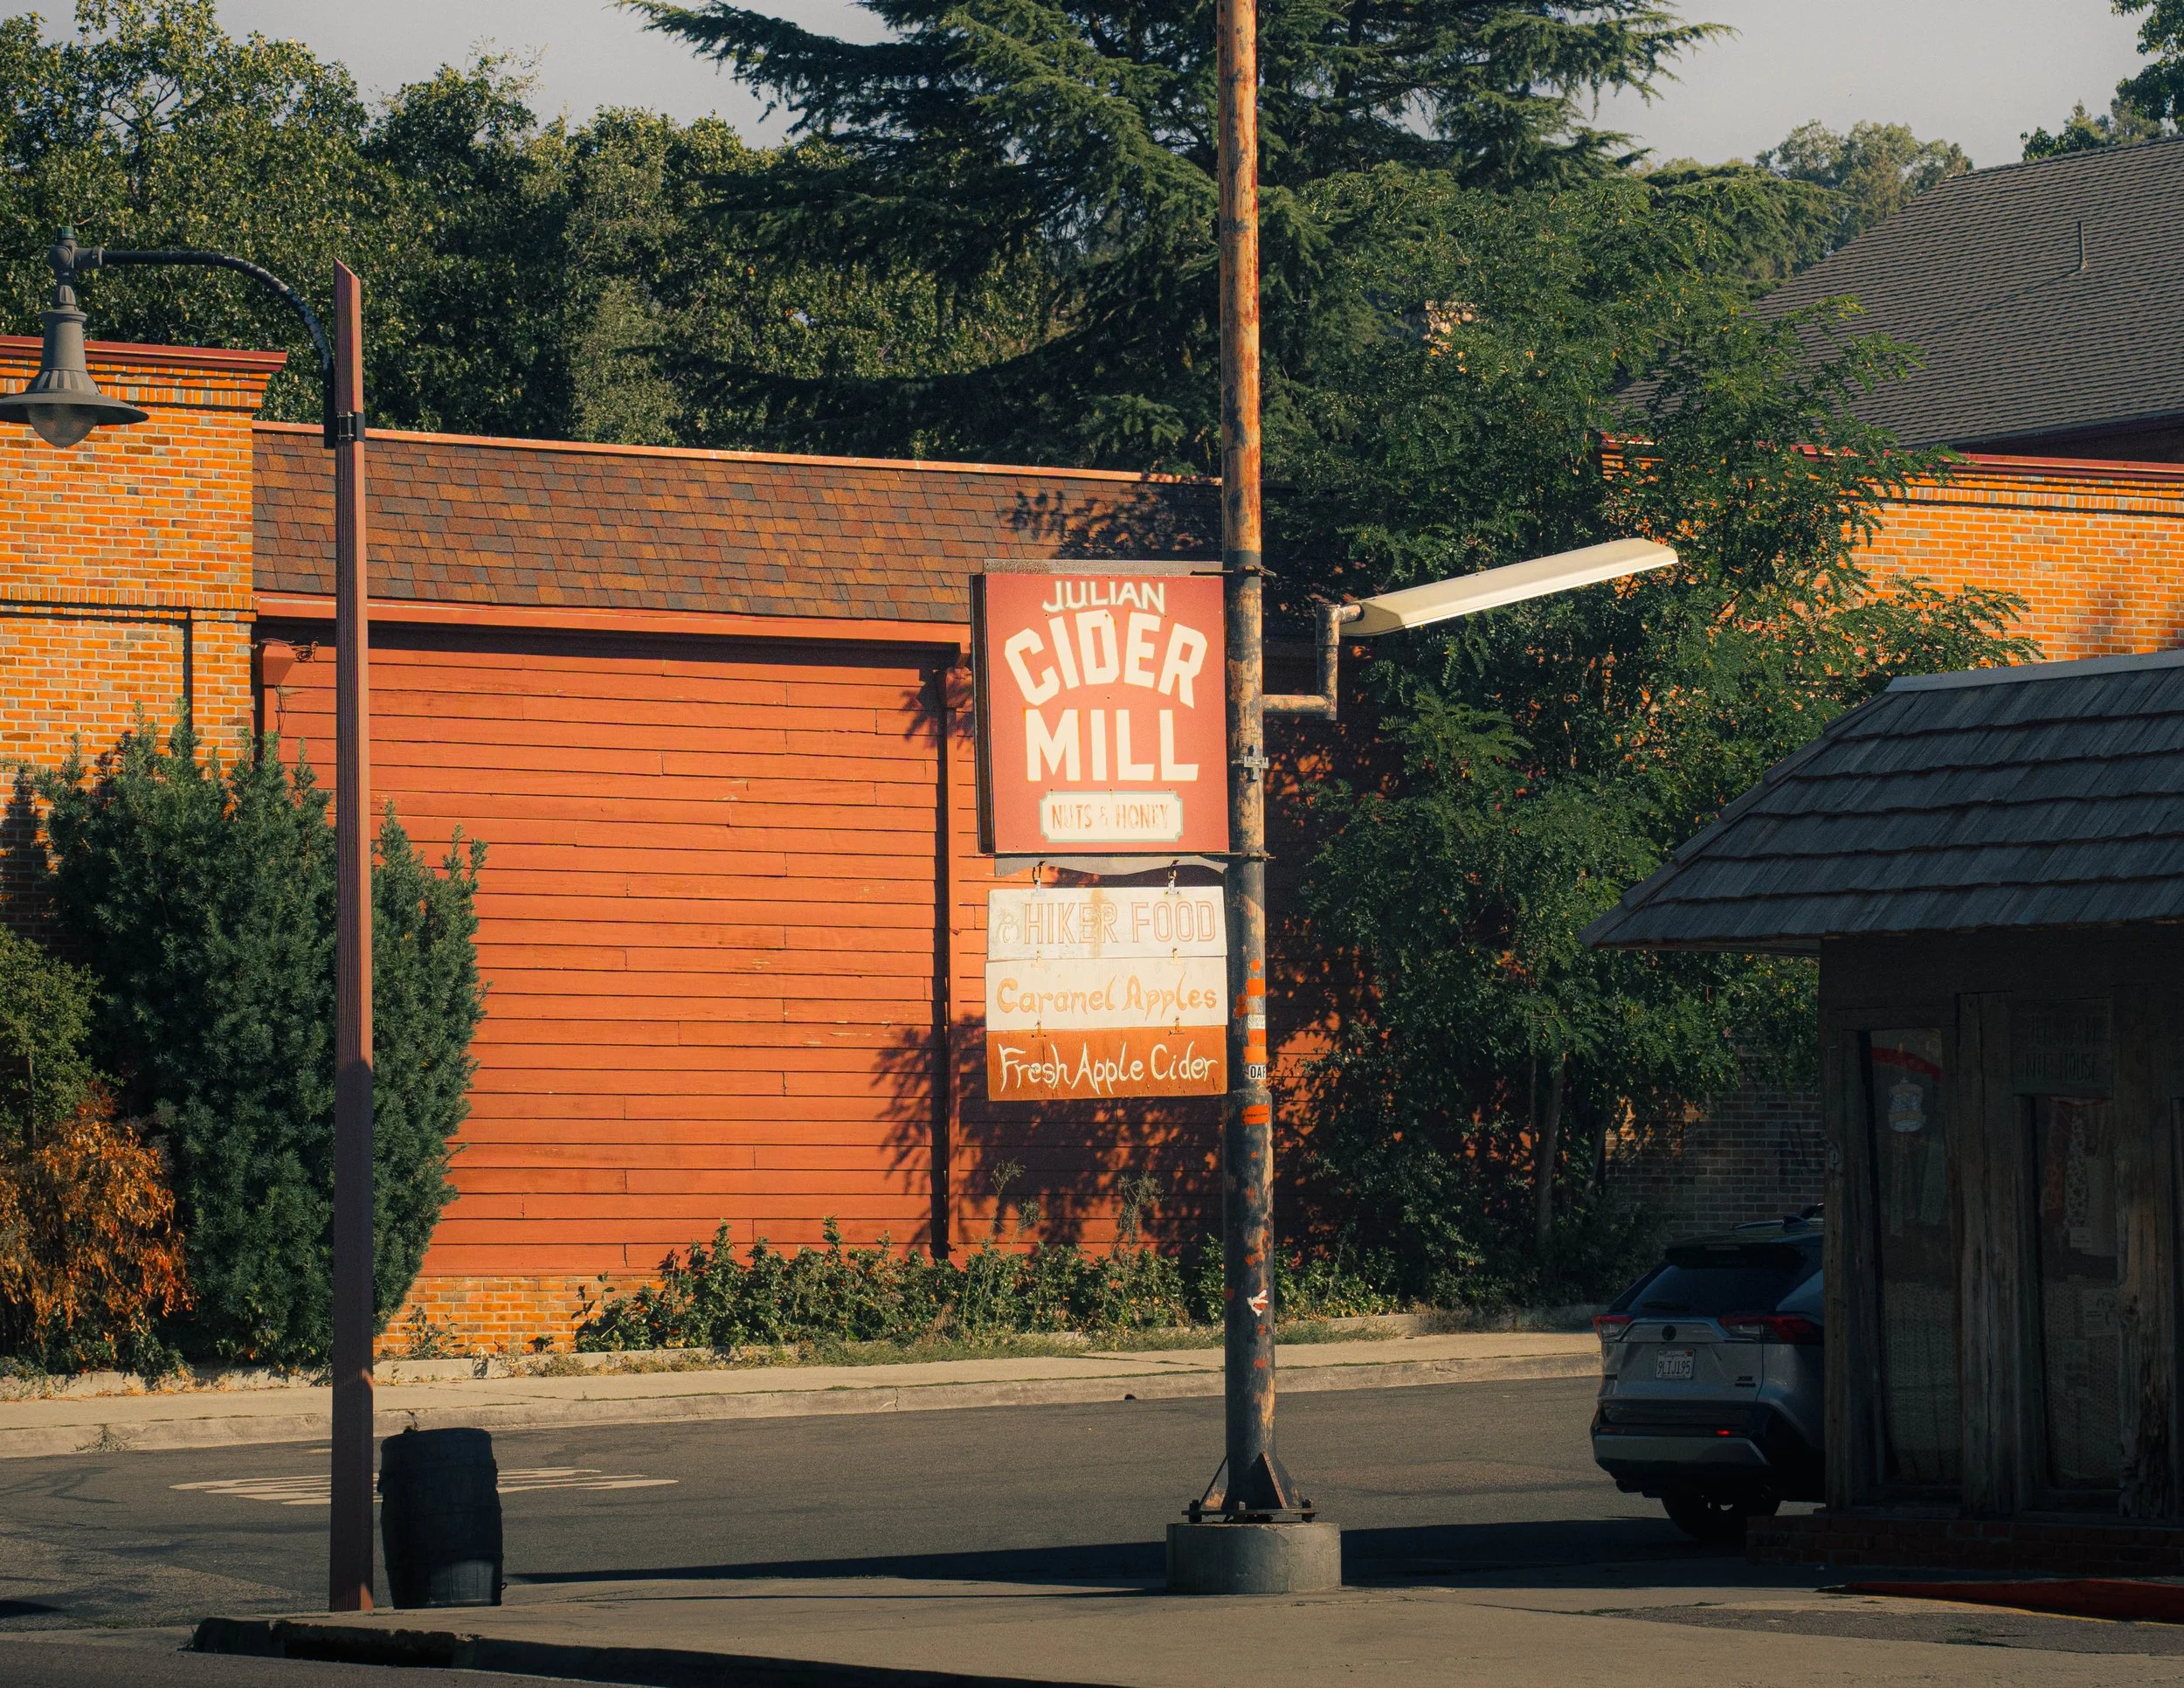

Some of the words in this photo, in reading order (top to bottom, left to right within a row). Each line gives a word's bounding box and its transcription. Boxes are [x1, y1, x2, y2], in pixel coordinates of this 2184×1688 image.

[1042, 579, 1166, 615] JULIAN
[1004, 609, 1208, 709] CIDER
[1025, 709, 1199, 782] MILL
[1051, 804, 1093, 829] NUTS
[1100, 806, 1109, 828] &
[1115, 804, 1170, 830] HONEY
[1023, 902, 1120, 944] HIKER
[1130, 900, 1217, 944] FOOD
[996, 973, 1116, 1017] Caramel
[1121, 971, 1218, 1021] Apples
[997, 1041, 1071, 1092] Fresh
[1070, 1041, 1144, 1095] Apple
[1150, 1040, 1220, 1083] Cider
[1657, 1359, 1691, 1375] 9LIJ195
